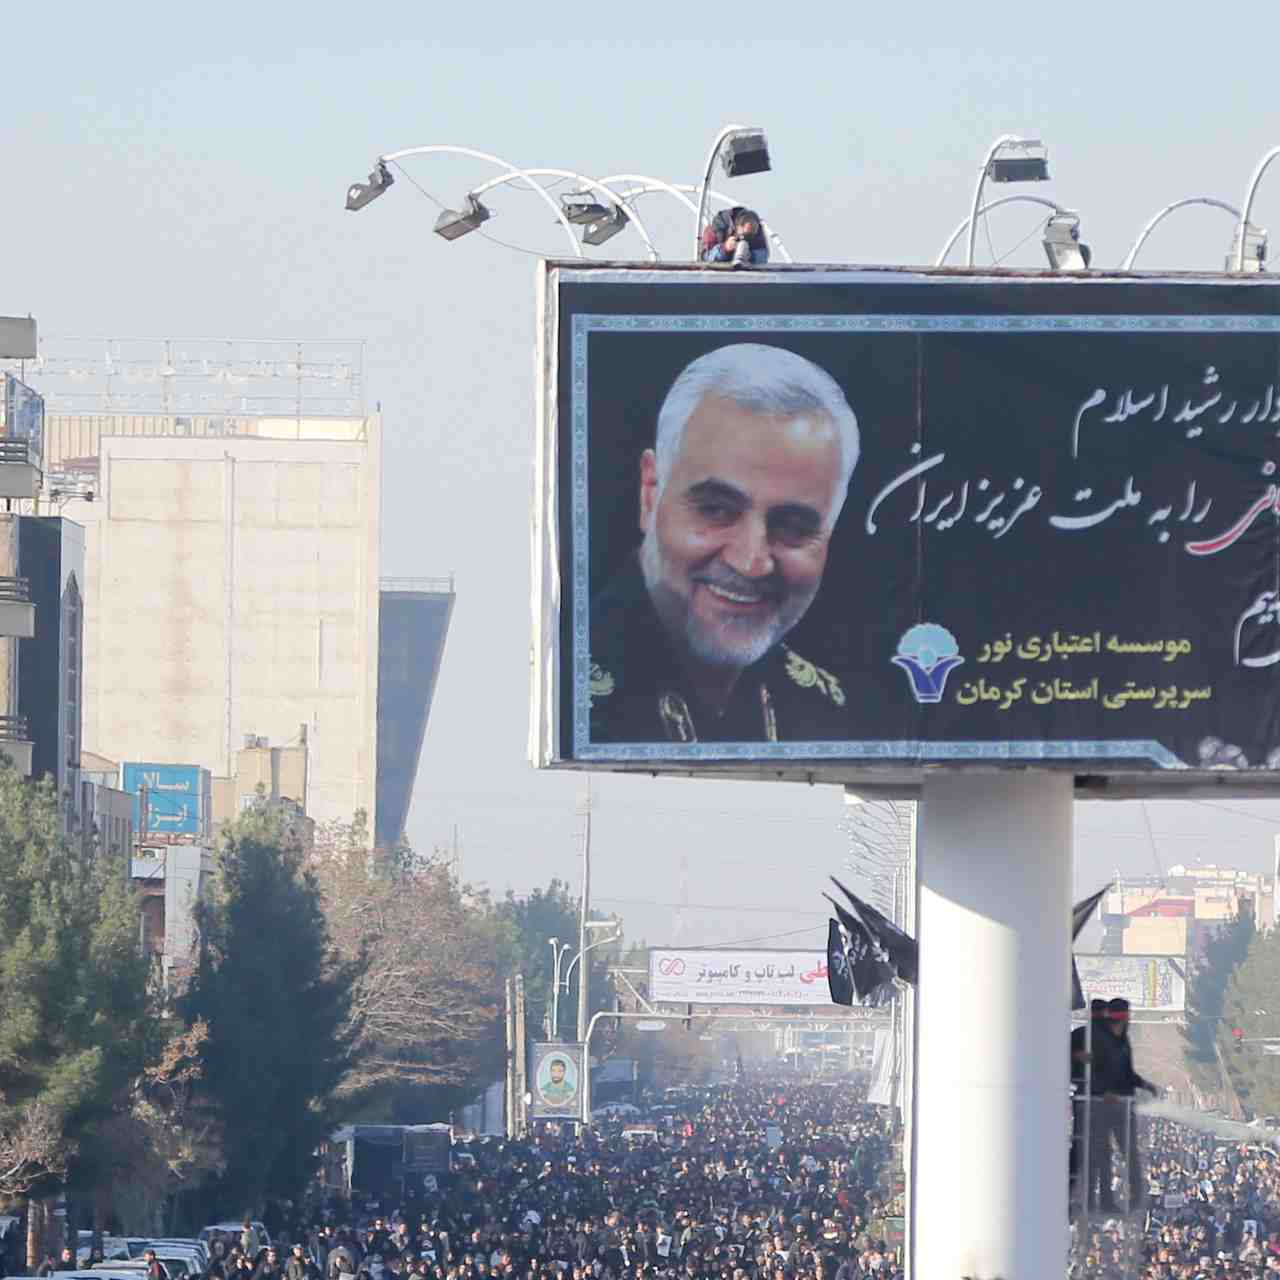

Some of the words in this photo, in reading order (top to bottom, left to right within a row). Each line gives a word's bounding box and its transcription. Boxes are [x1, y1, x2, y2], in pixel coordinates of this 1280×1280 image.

[1073, 384, 1170, 460] اسلام
[1173, 365, 1237, 438] رشید
[865, 441, 971, 536] ایران
[974, 476, 1043, 540] عزیز
[1048, 475, 1143, 530] ملت
[1178, 479, 1213, 523] را
[1148, 501, 1174, 544] به
[976, 632, 1014, 663] نور
[1015, 631, 1102, 663] اعتباری
[1105, 637, 1192, 665] موسسه
[955, 677, 1027, 708] کرمان
[1030, 677, 1099, 705] استان
[1101, 679, 1213, 709] سرپرستی
